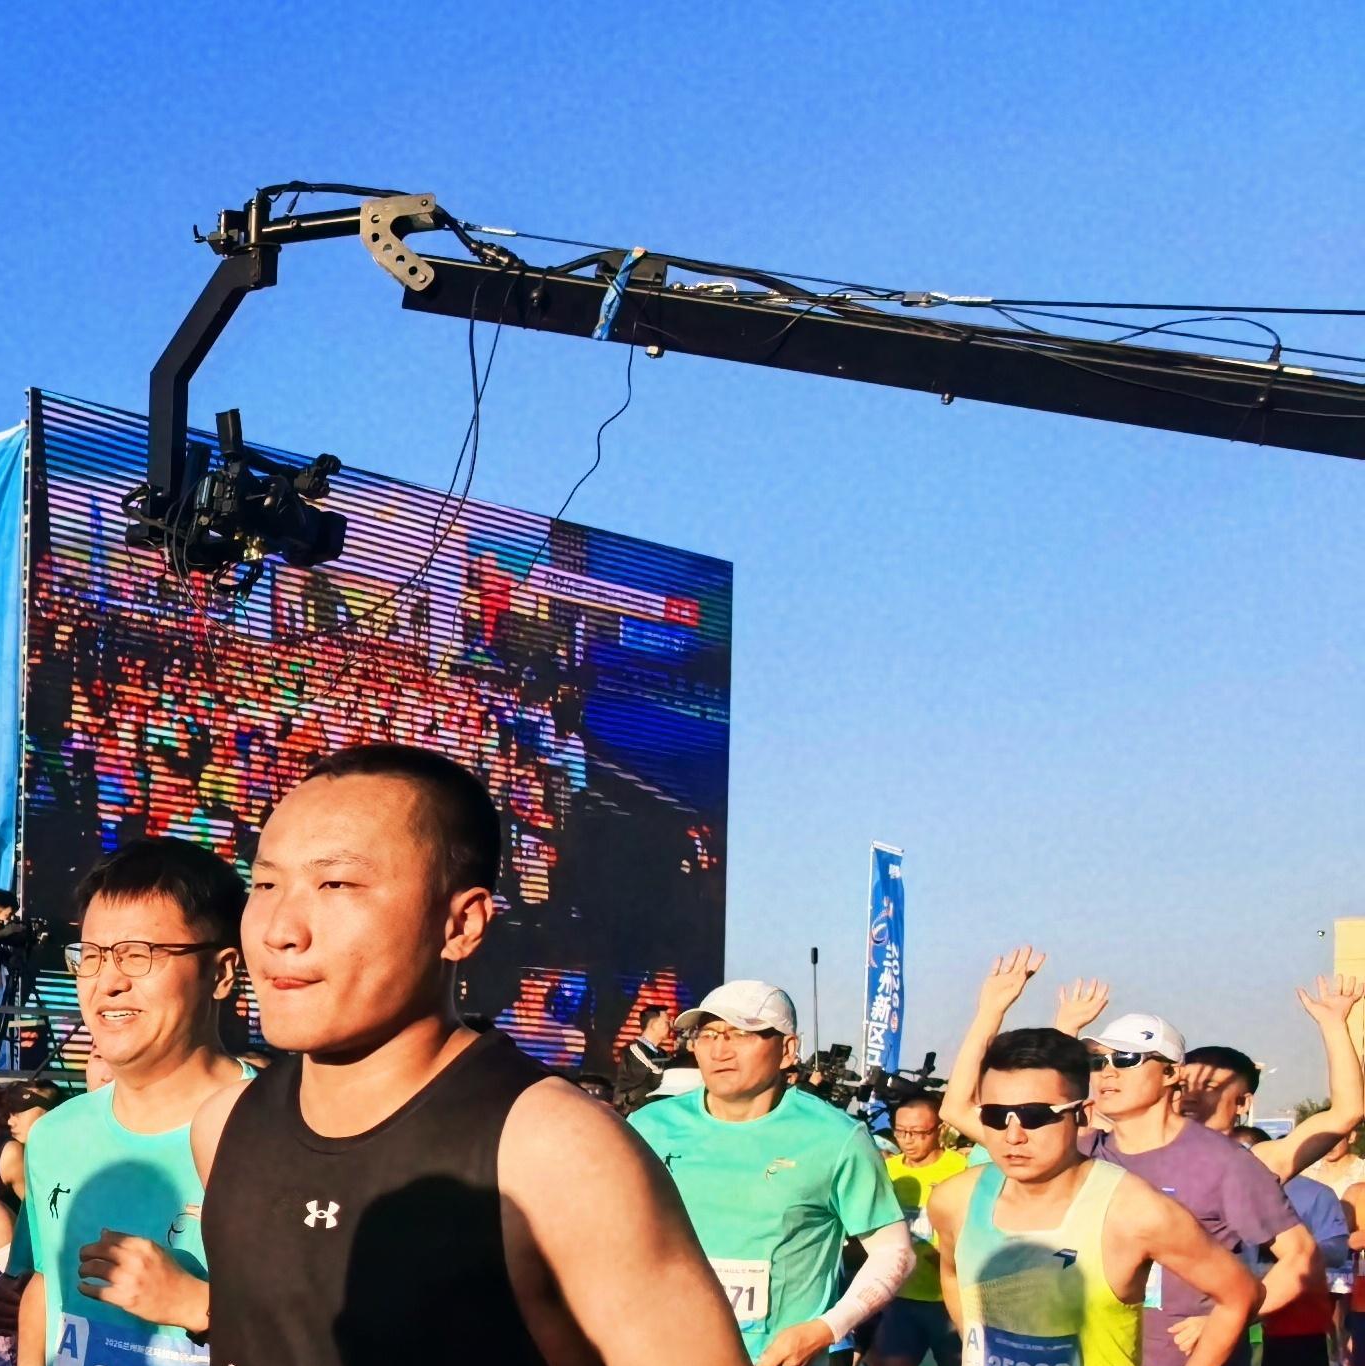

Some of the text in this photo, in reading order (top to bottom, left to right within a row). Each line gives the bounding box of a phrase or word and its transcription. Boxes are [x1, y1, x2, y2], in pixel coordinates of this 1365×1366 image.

[722, 1285, 755, 1311] 71
[57, 1323, 78, 1359] A
[967, 1327, 979, 1350] A
